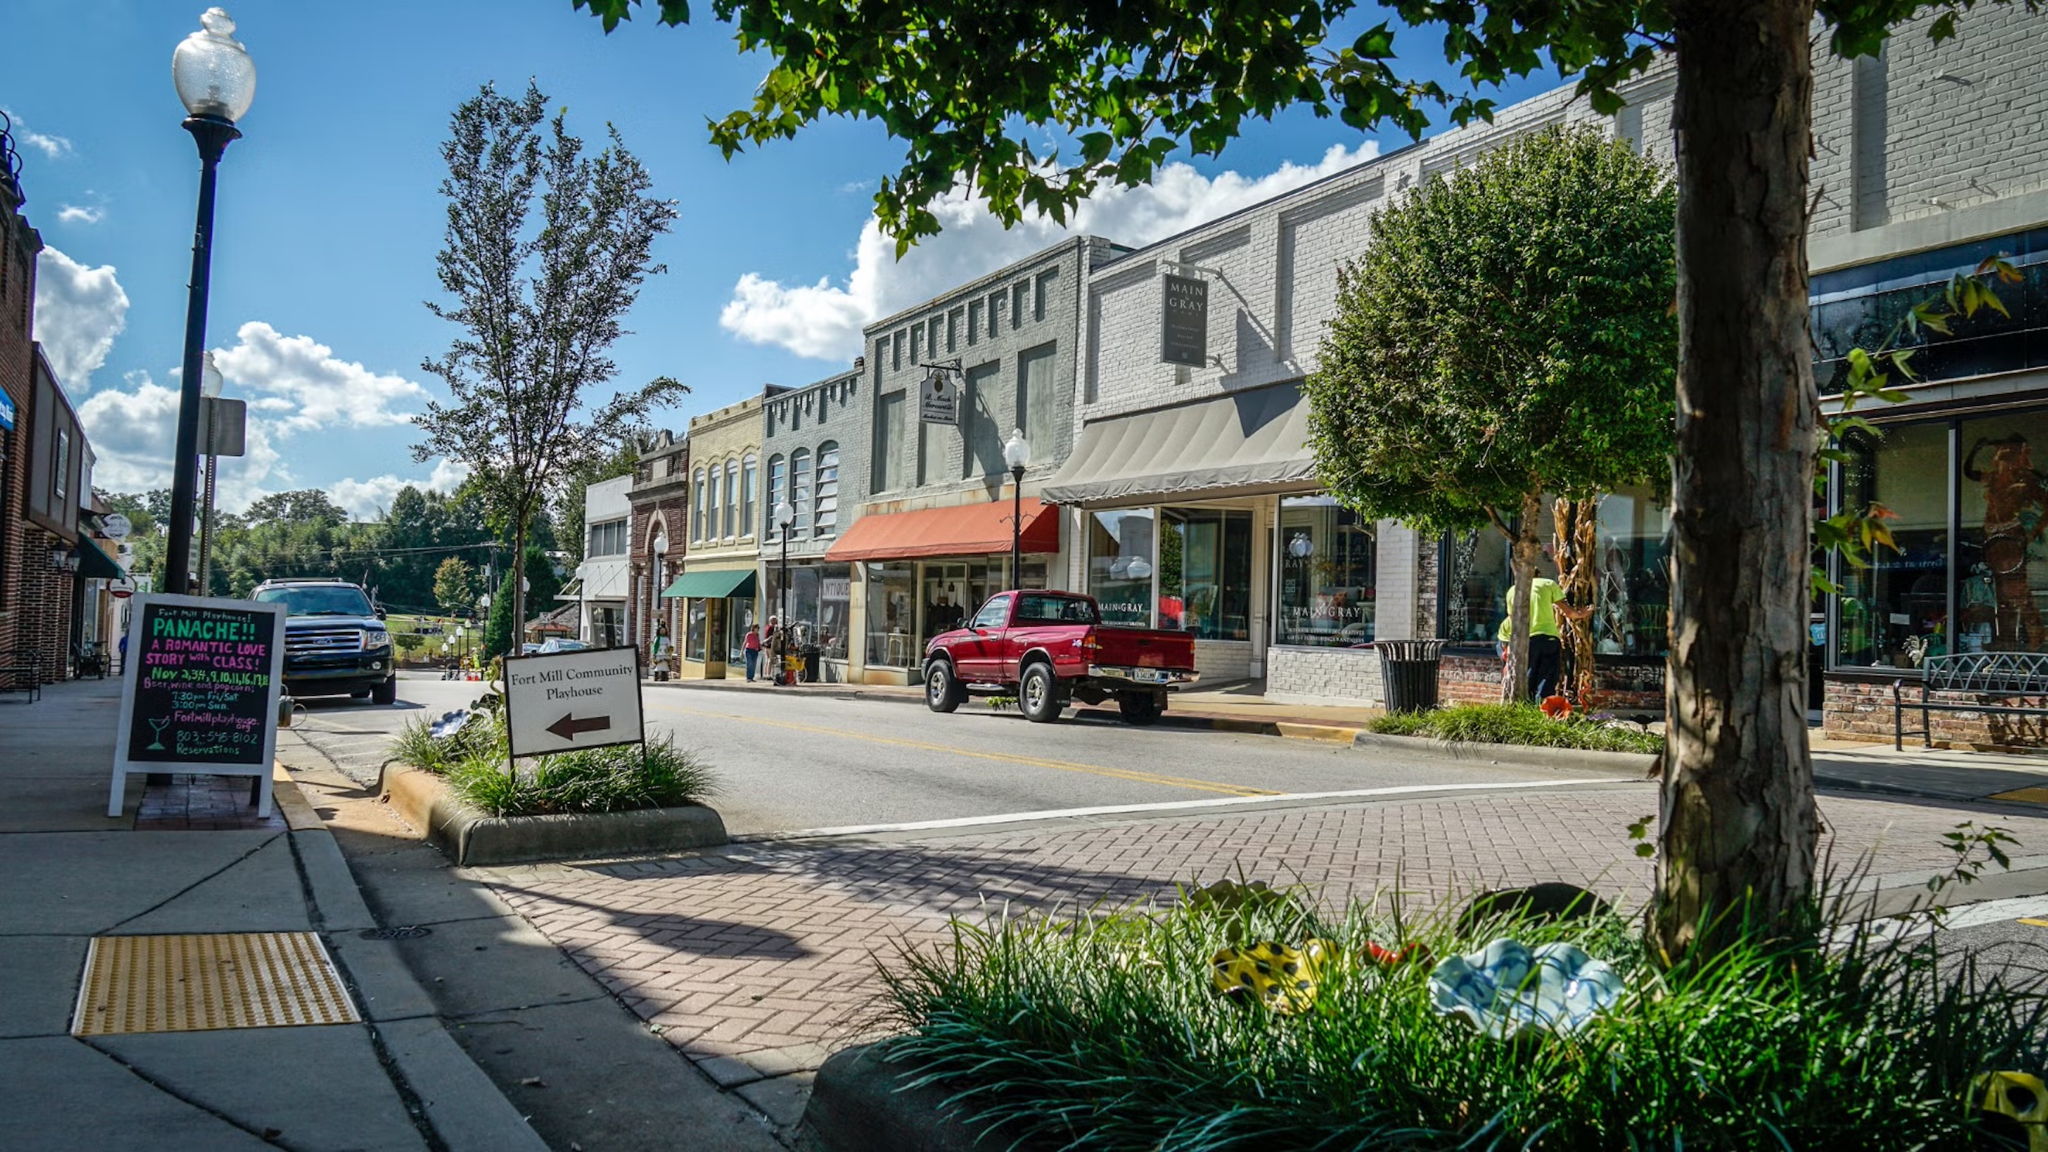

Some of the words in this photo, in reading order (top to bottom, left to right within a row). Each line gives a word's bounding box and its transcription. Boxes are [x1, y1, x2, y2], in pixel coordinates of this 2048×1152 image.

[1170, 283, 1203, 296] MAIN
[1169, 298, 1203, 311] GRAY
[1121, 603, 1143, 612] GRAY
[1328, 607, 1360, 618] GRAY
[153, 618, 255, 640] PANACHE!!
[151, 639, 160, 650] A
[165, 639, 233, 653] ROMANTIC
[237, 642, 266, 656] LOVE
[145, 652, 185, 665] STORY
[213, 656, 260, 671] CLASS!
[152, 667, 178, 680] Nov
[511, 674, 535, 686] Fort
[540, 669, 563, 683] Mill
[566, 664, 633, 680] Community
[196, 681, 211, 689] and
[546, 685, 603, 700] Playhouse
[176, 743, 240, 756] Reservations
